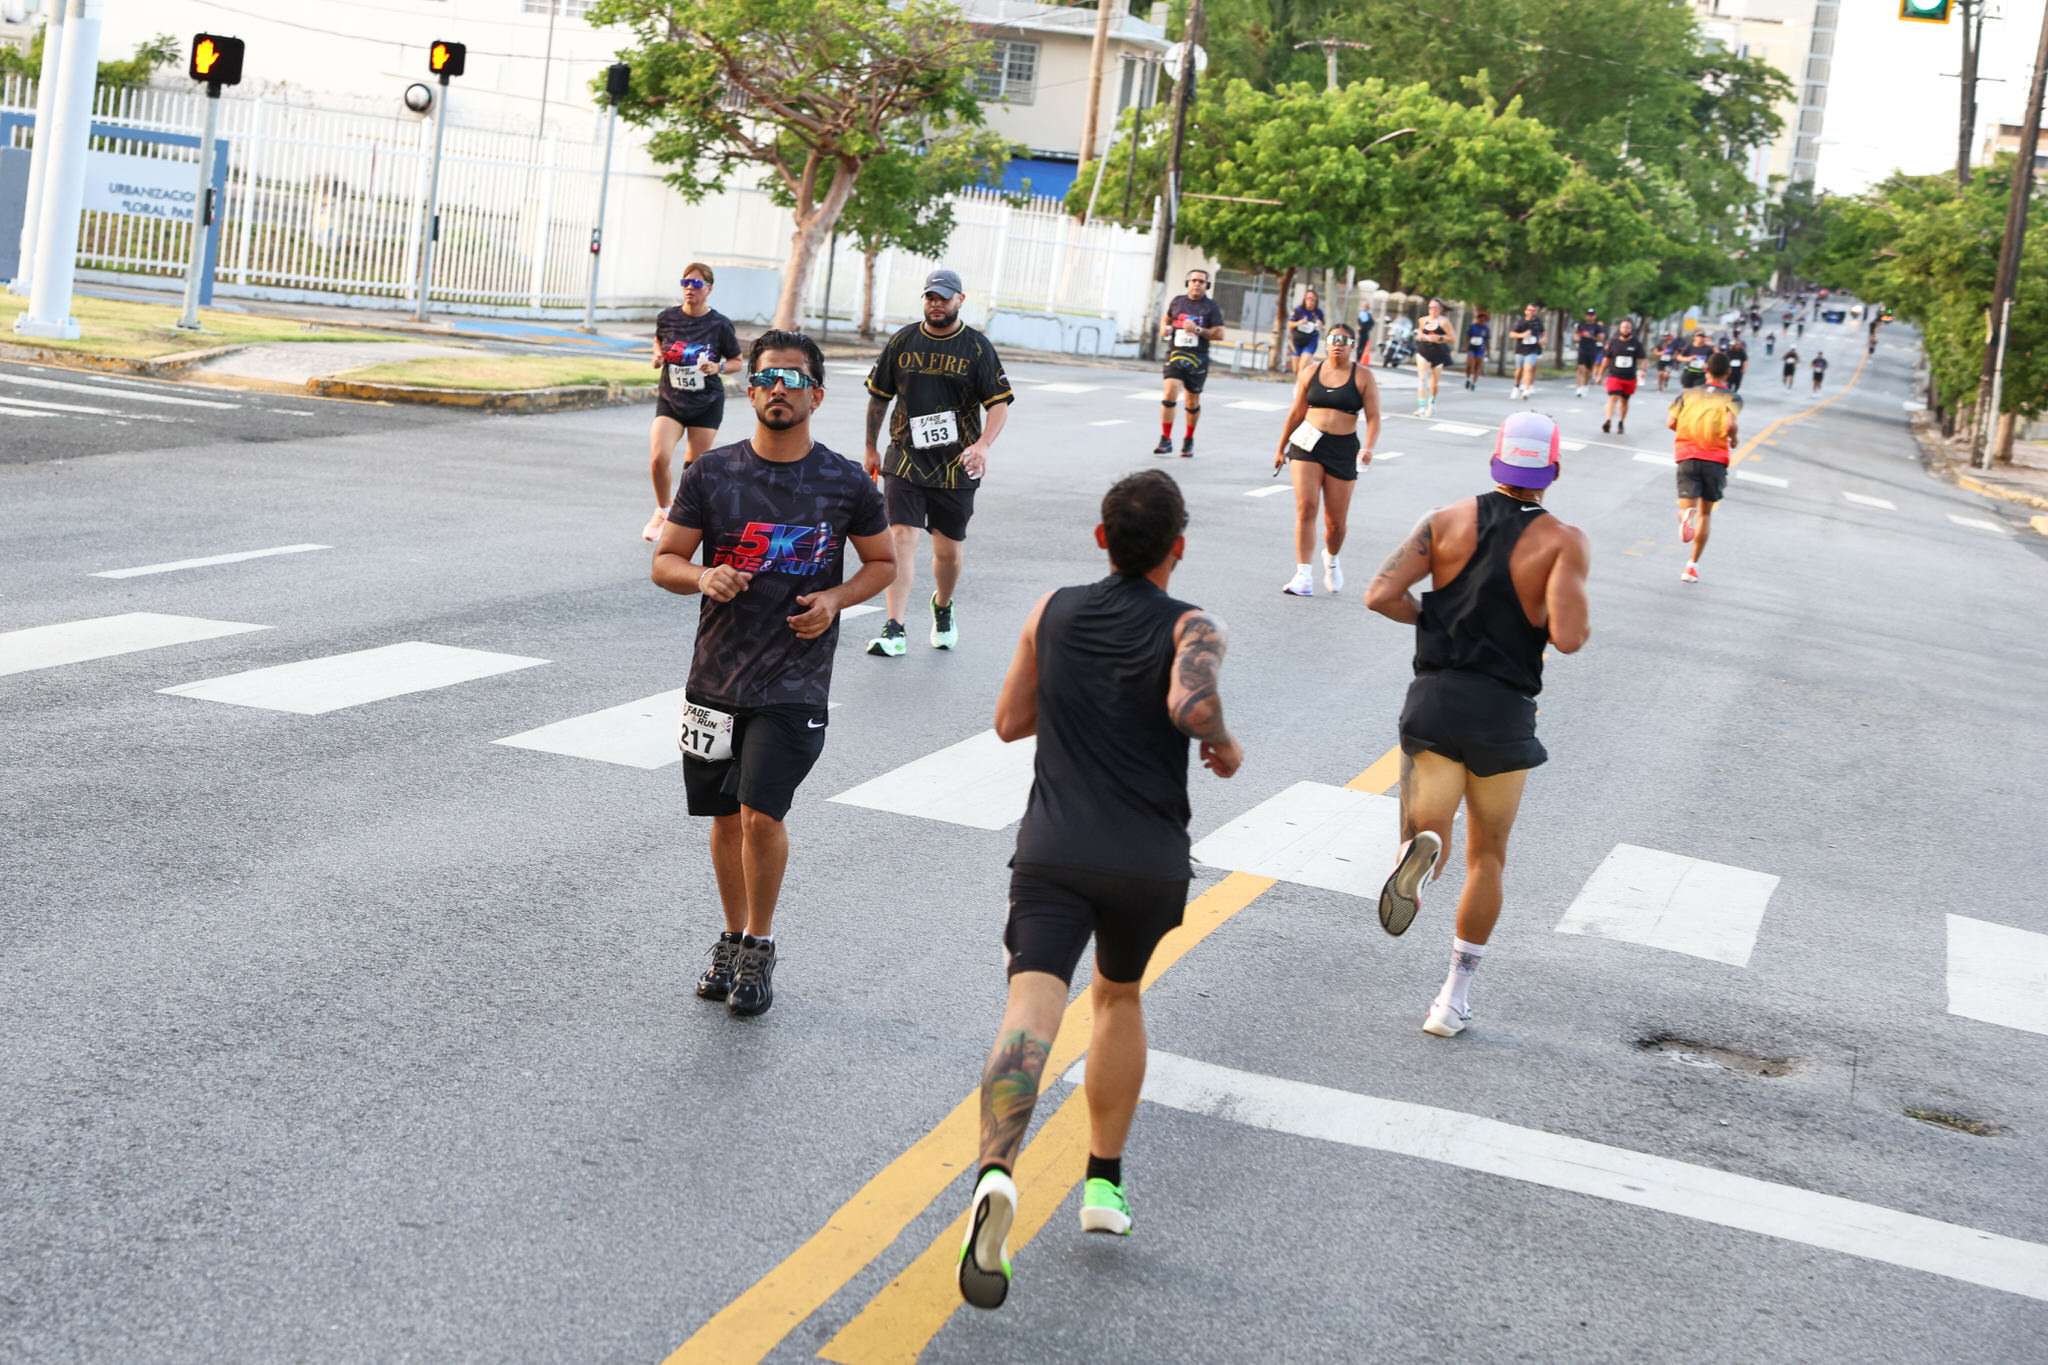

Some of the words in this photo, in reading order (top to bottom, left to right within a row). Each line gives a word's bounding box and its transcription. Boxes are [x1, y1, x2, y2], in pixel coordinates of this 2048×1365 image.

[171, 206, 193, 218] PAR
[898, 352, 925, 368] ON
[929, 352, 971, 376] FIRE
[677, 377, 696, 387] 154
[922, 427, 949, 443] 153
[735, 521, 816, 560] 5K
[713, 552, 763, 571] FADE
[759, 560, 773, 572] &
[685, 705, 710, 719] FADE
[697, 718, 718, 729] RUN
[681, 722, 715, 754] 217
